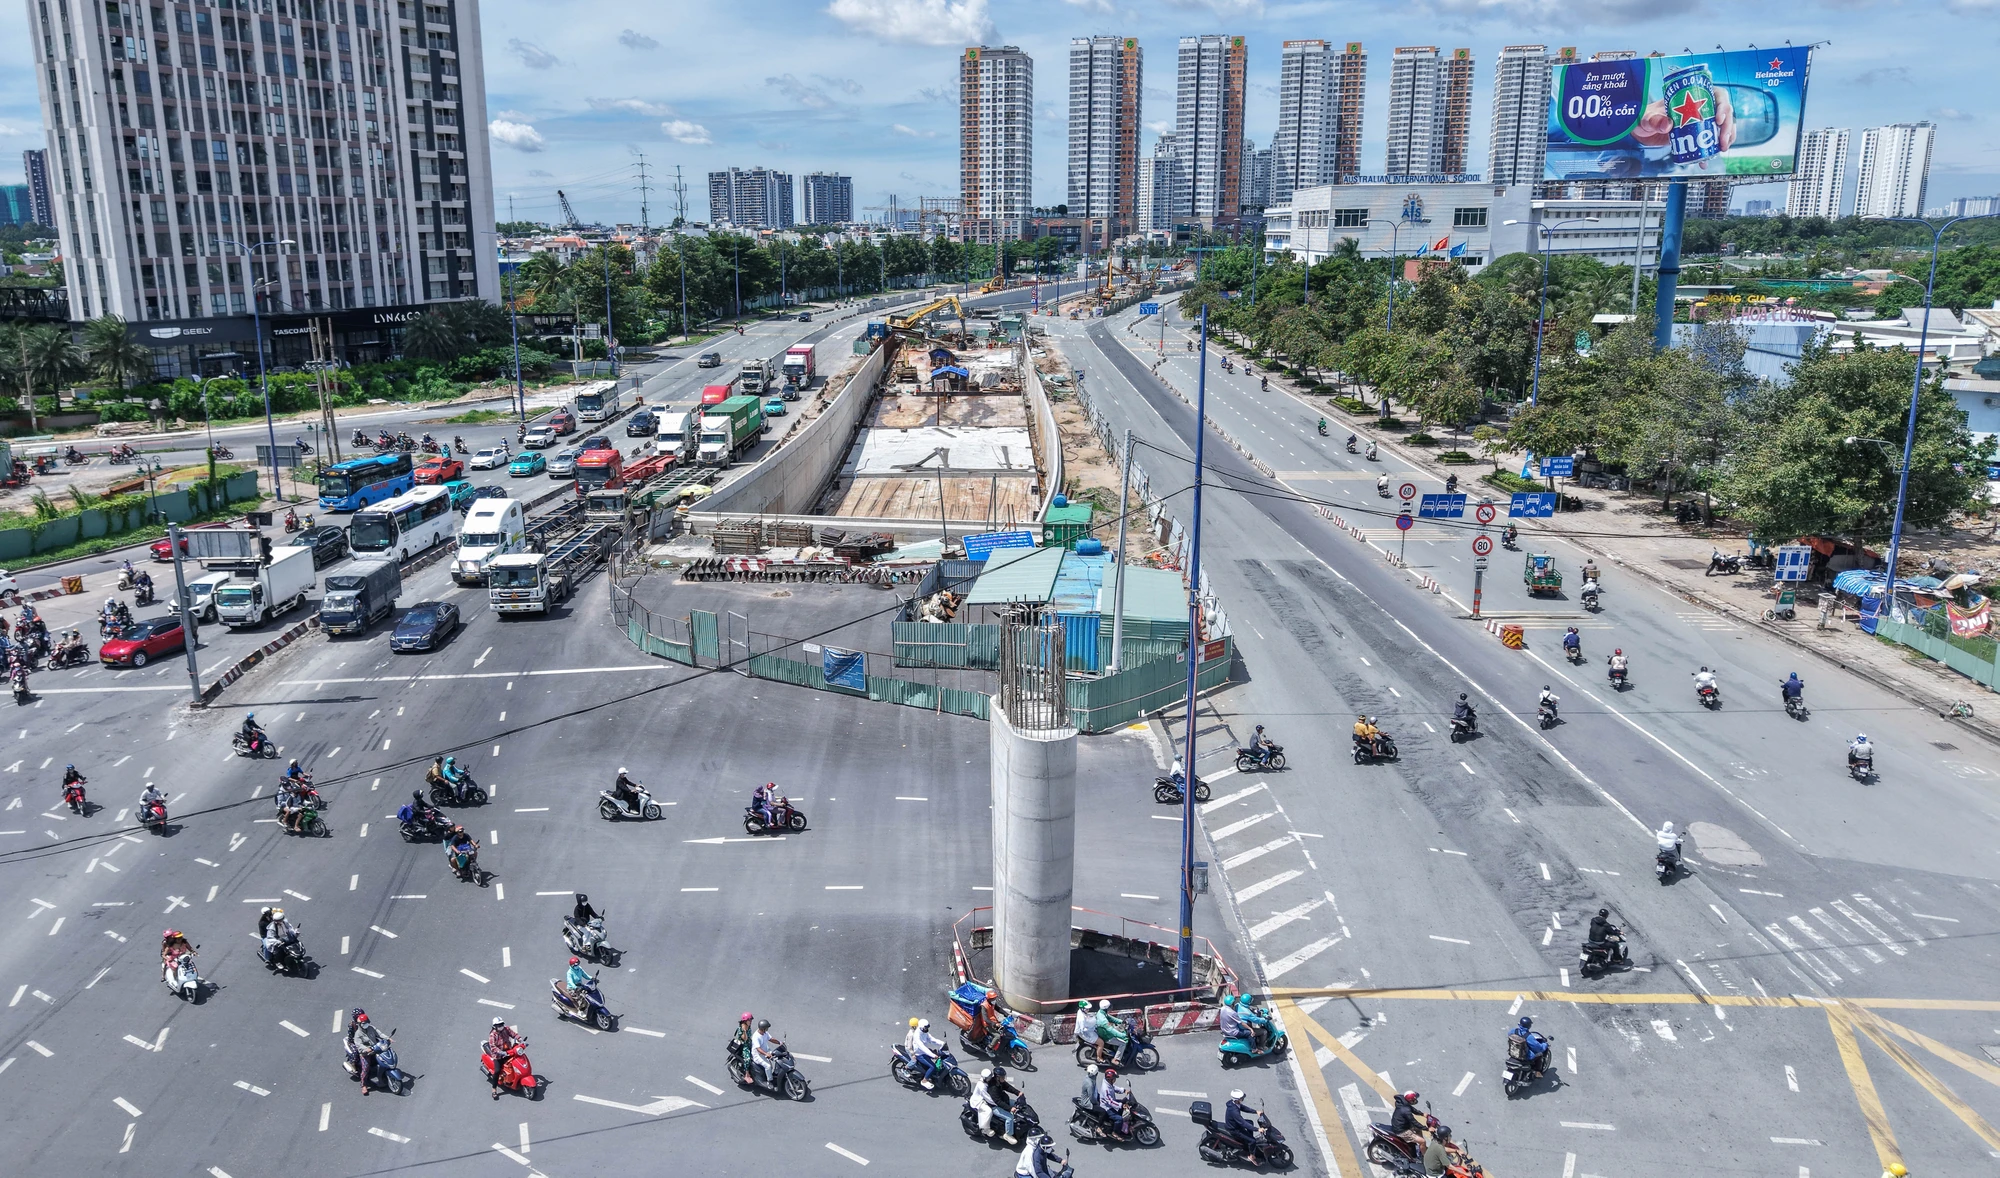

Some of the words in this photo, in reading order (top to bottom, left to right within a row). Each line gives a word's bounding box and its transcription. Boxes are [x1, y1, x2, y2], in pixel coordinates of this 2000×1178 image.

[1585, 72, 1599, 82] Êm
[1343, 175, 1391, 184] AUSTRALIAN
[1393, 174, 1449, 184] INTERNATIONAL
[1453, 173, 1482, 183] SCHOOL
[1747, 294, 1767, 303] GIA
[1741, 306, 1767, 322] HOA
[182, 327, 213, 336] GEELY
[273, 328, 299, 336] TASCO
[1402, 487, 1412, 496] 60
[1477, 541, 1488, 551] 80
